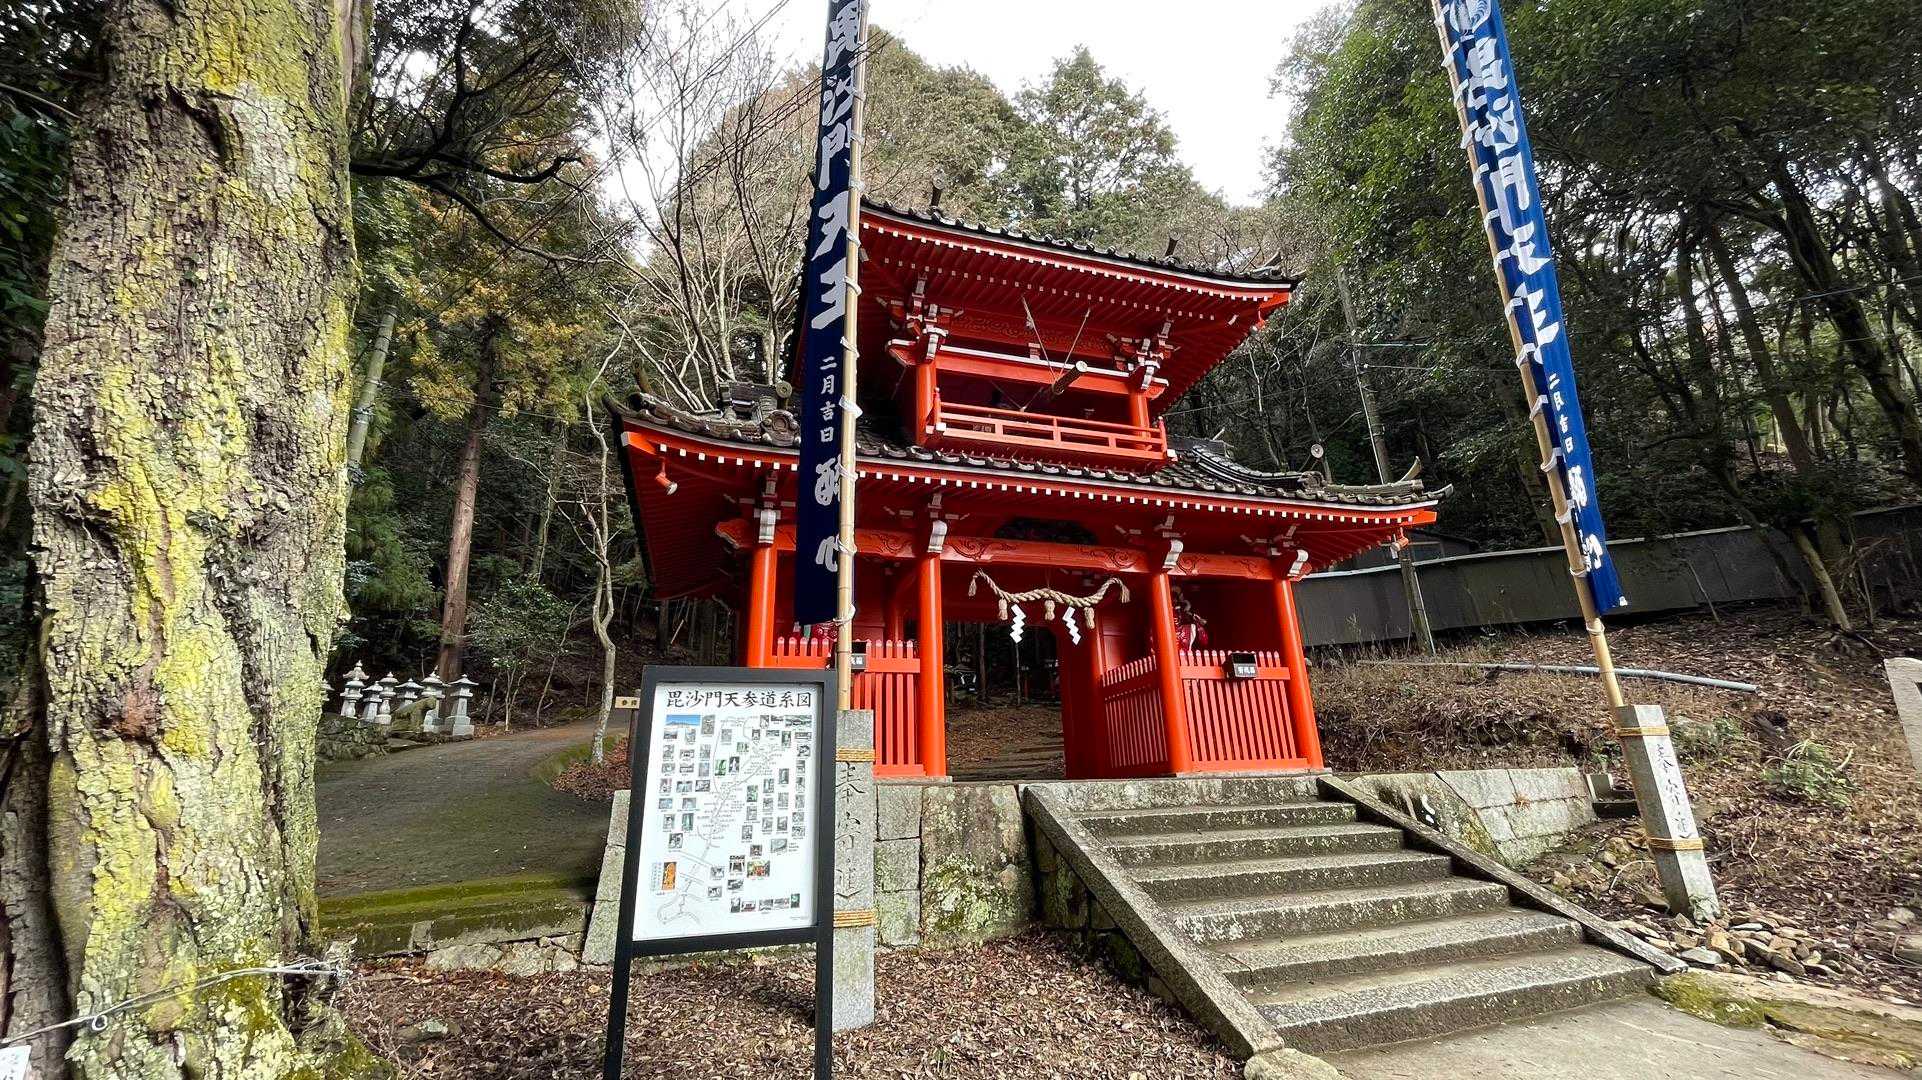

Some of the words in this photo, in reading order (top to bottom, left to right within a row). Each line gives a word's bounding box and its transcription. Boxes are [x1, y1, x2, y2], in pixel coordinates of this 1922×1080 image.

[819, 355, 837, 442] 二月吉日
[666, 690, 813, 709] 毘沙門天参道系図
